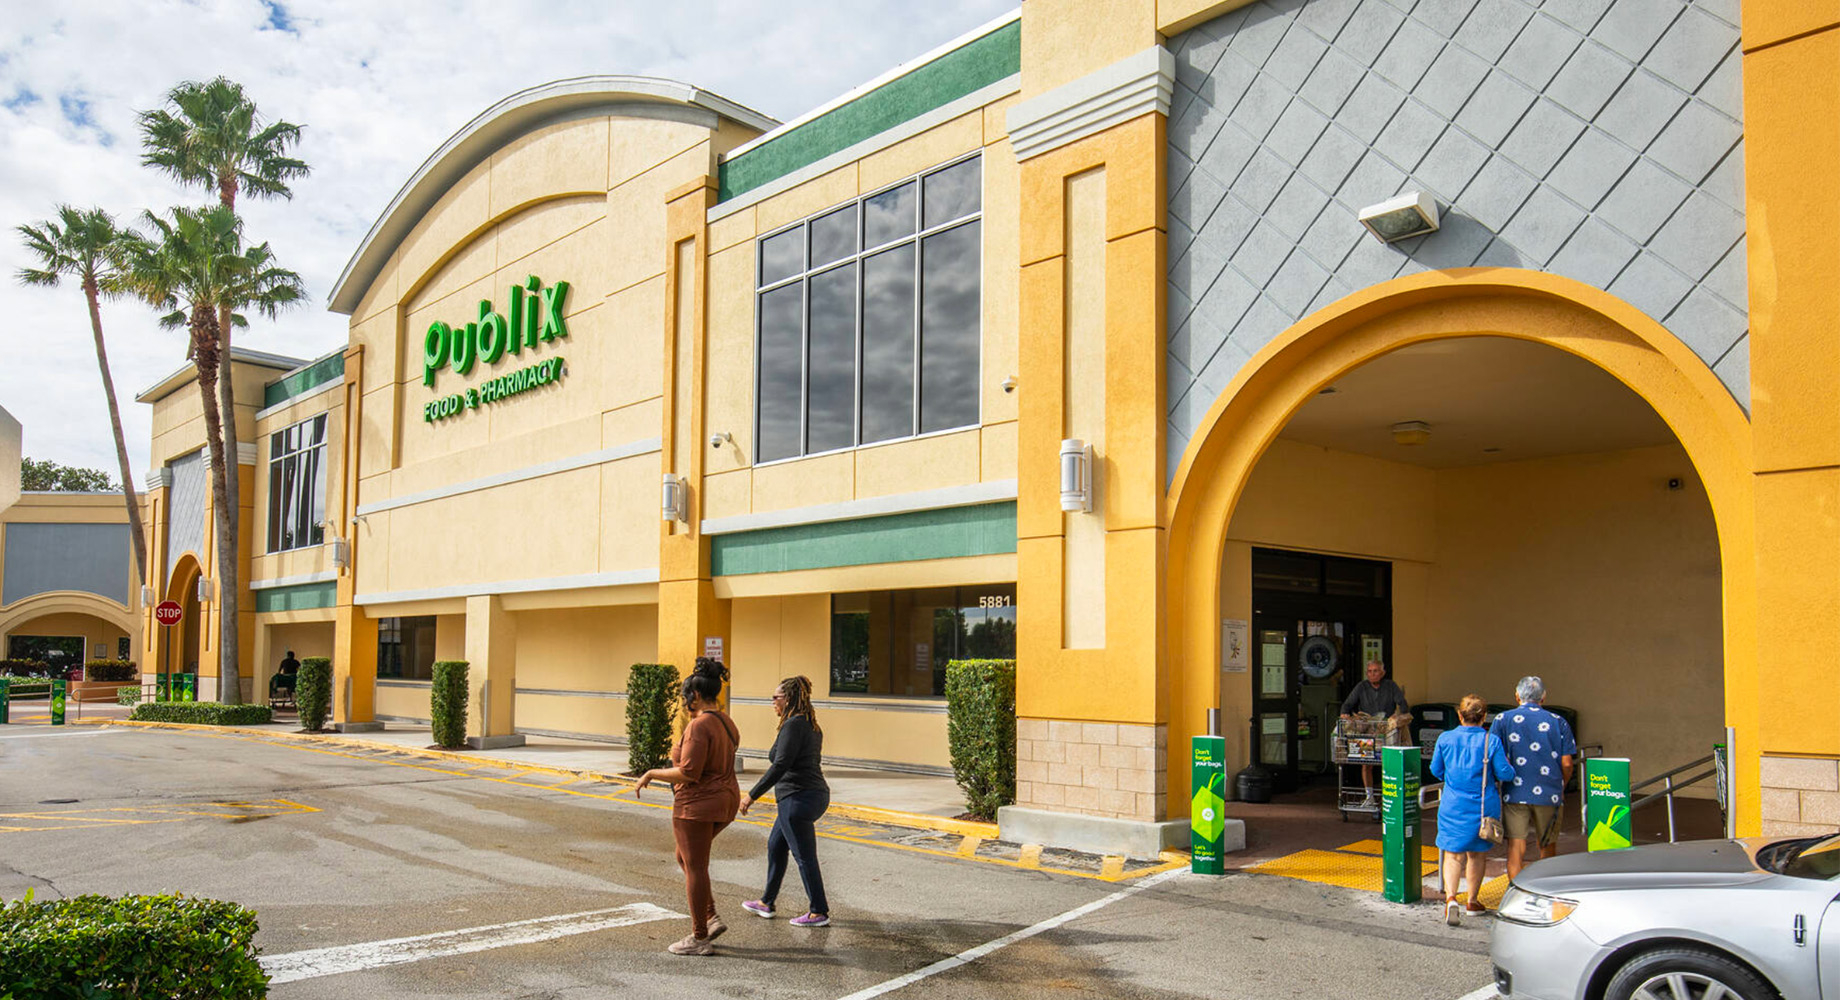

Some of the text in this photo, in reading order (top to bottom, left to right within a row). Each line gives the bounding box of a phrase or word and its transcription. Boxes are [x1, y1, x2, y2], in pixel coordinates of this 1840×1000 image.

[424, 356, 564, 422] FOOD & PHARMACY
[979, 595, 1011, 609] 5881
[157, 607, 181, 618] STOP
[1590, 773, 1608, 782] Don't
[1590, 781, 1611, 790] forget
[1590, 789, 1626, 799] your bags.
